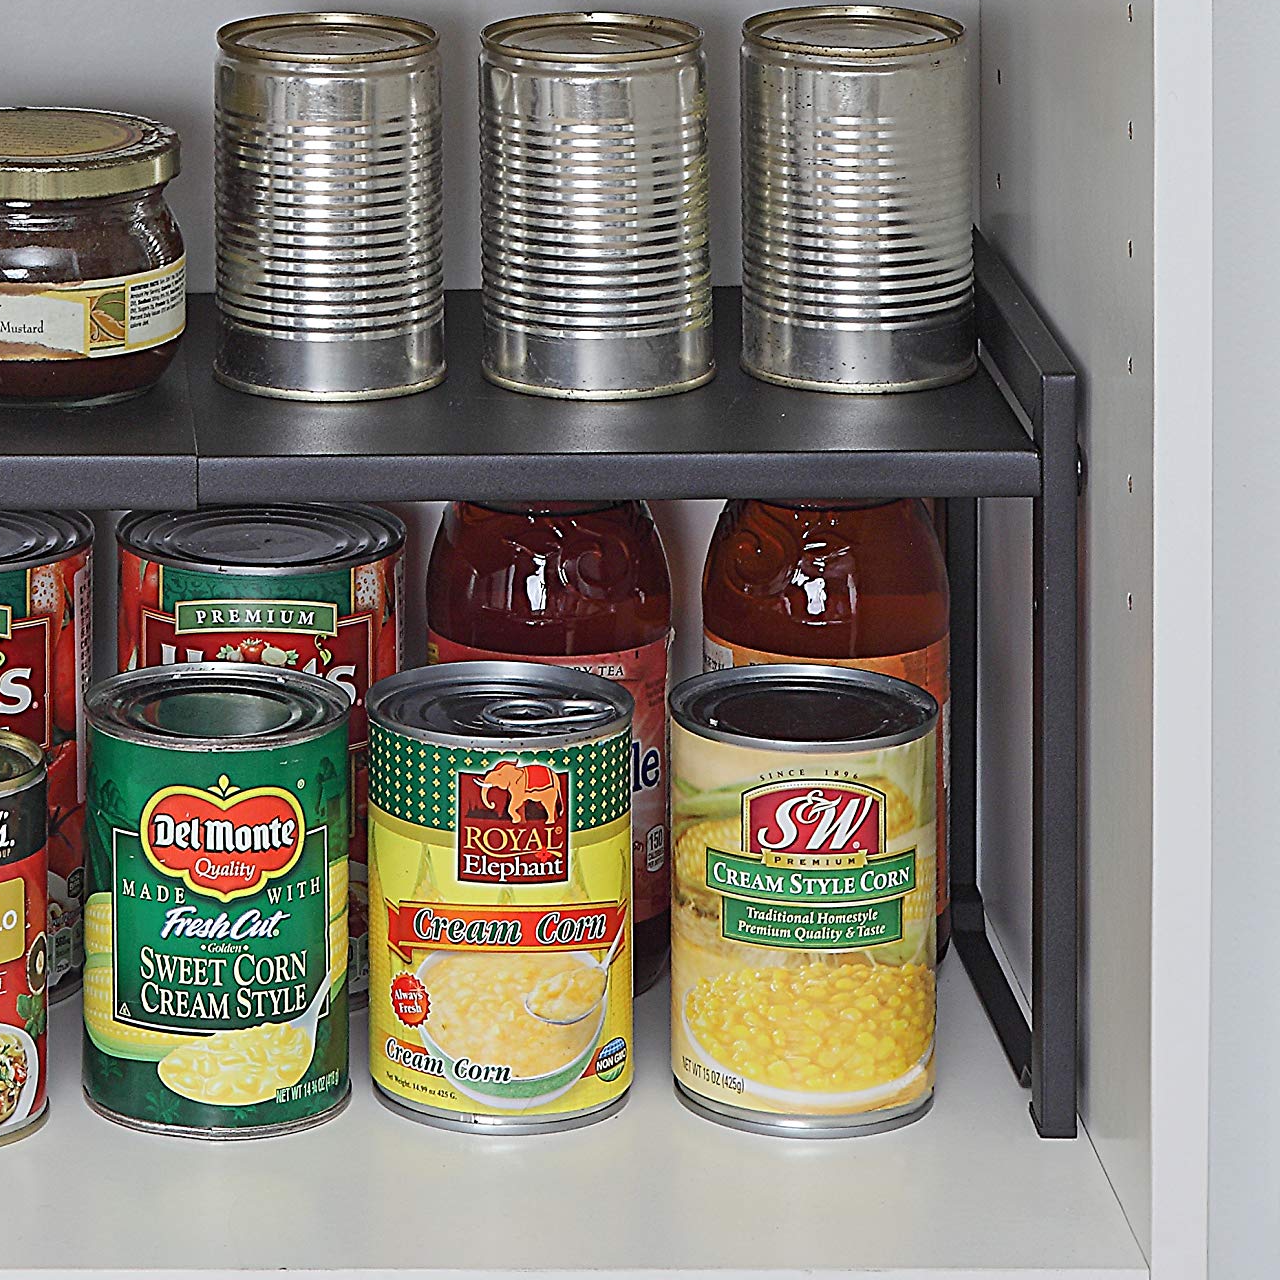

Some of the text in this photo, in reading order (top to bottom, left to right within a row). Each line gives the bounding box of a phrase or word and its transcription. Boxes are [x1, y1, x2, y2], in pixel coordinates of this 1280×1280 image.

[0, 320, 44, 334] Mustard
[196, 610, 315, 626] PREMIUM
[598, 666, 624, 676] TEA
[759, 769, 859, 781] SINCE 1896
[758, 790, 873, 850] S&W
[154, 815, 295, 853] Del Monte
[464, 826, 563, 850] ROYAL
[649, 829, 662, 851] 150
[195, 858, 256, 881] Quality
[463, 853, 563, 882] Elephant
[774, 856, 857, 866] PREMIUM
[713, 862, 910, 896] CREAM STYLE CORN
[122, 876, 321, 905] MADE WITH
[161, 906, 290, 940] Fresh Cut
[413, 907, 607, 945] Cream Corn
[746, 906, 878, 925] Traditional Homestyle
[738, 920, 885, 942] Premium Quality & Taste
[207, 943, 242, 953] Golden
[141, 946, 308, 986] SWEET CORN
[141, 982, 308, 1019] CREAM STYLE
[394, 988, 424, 1003] Always
[398, 1002, 422, 1014] Fresh
[385, 1037, 512, 1085] Cream Corn
[596, 1056, 614, 1071] NON
[682, 1055, 745, 1094] NET WT 15 OZ (425g)
[276, 1088, 290, 1103] NET
[291, 1084, 302, 1100] WT
[304, 1082, 311, 1097] 14
